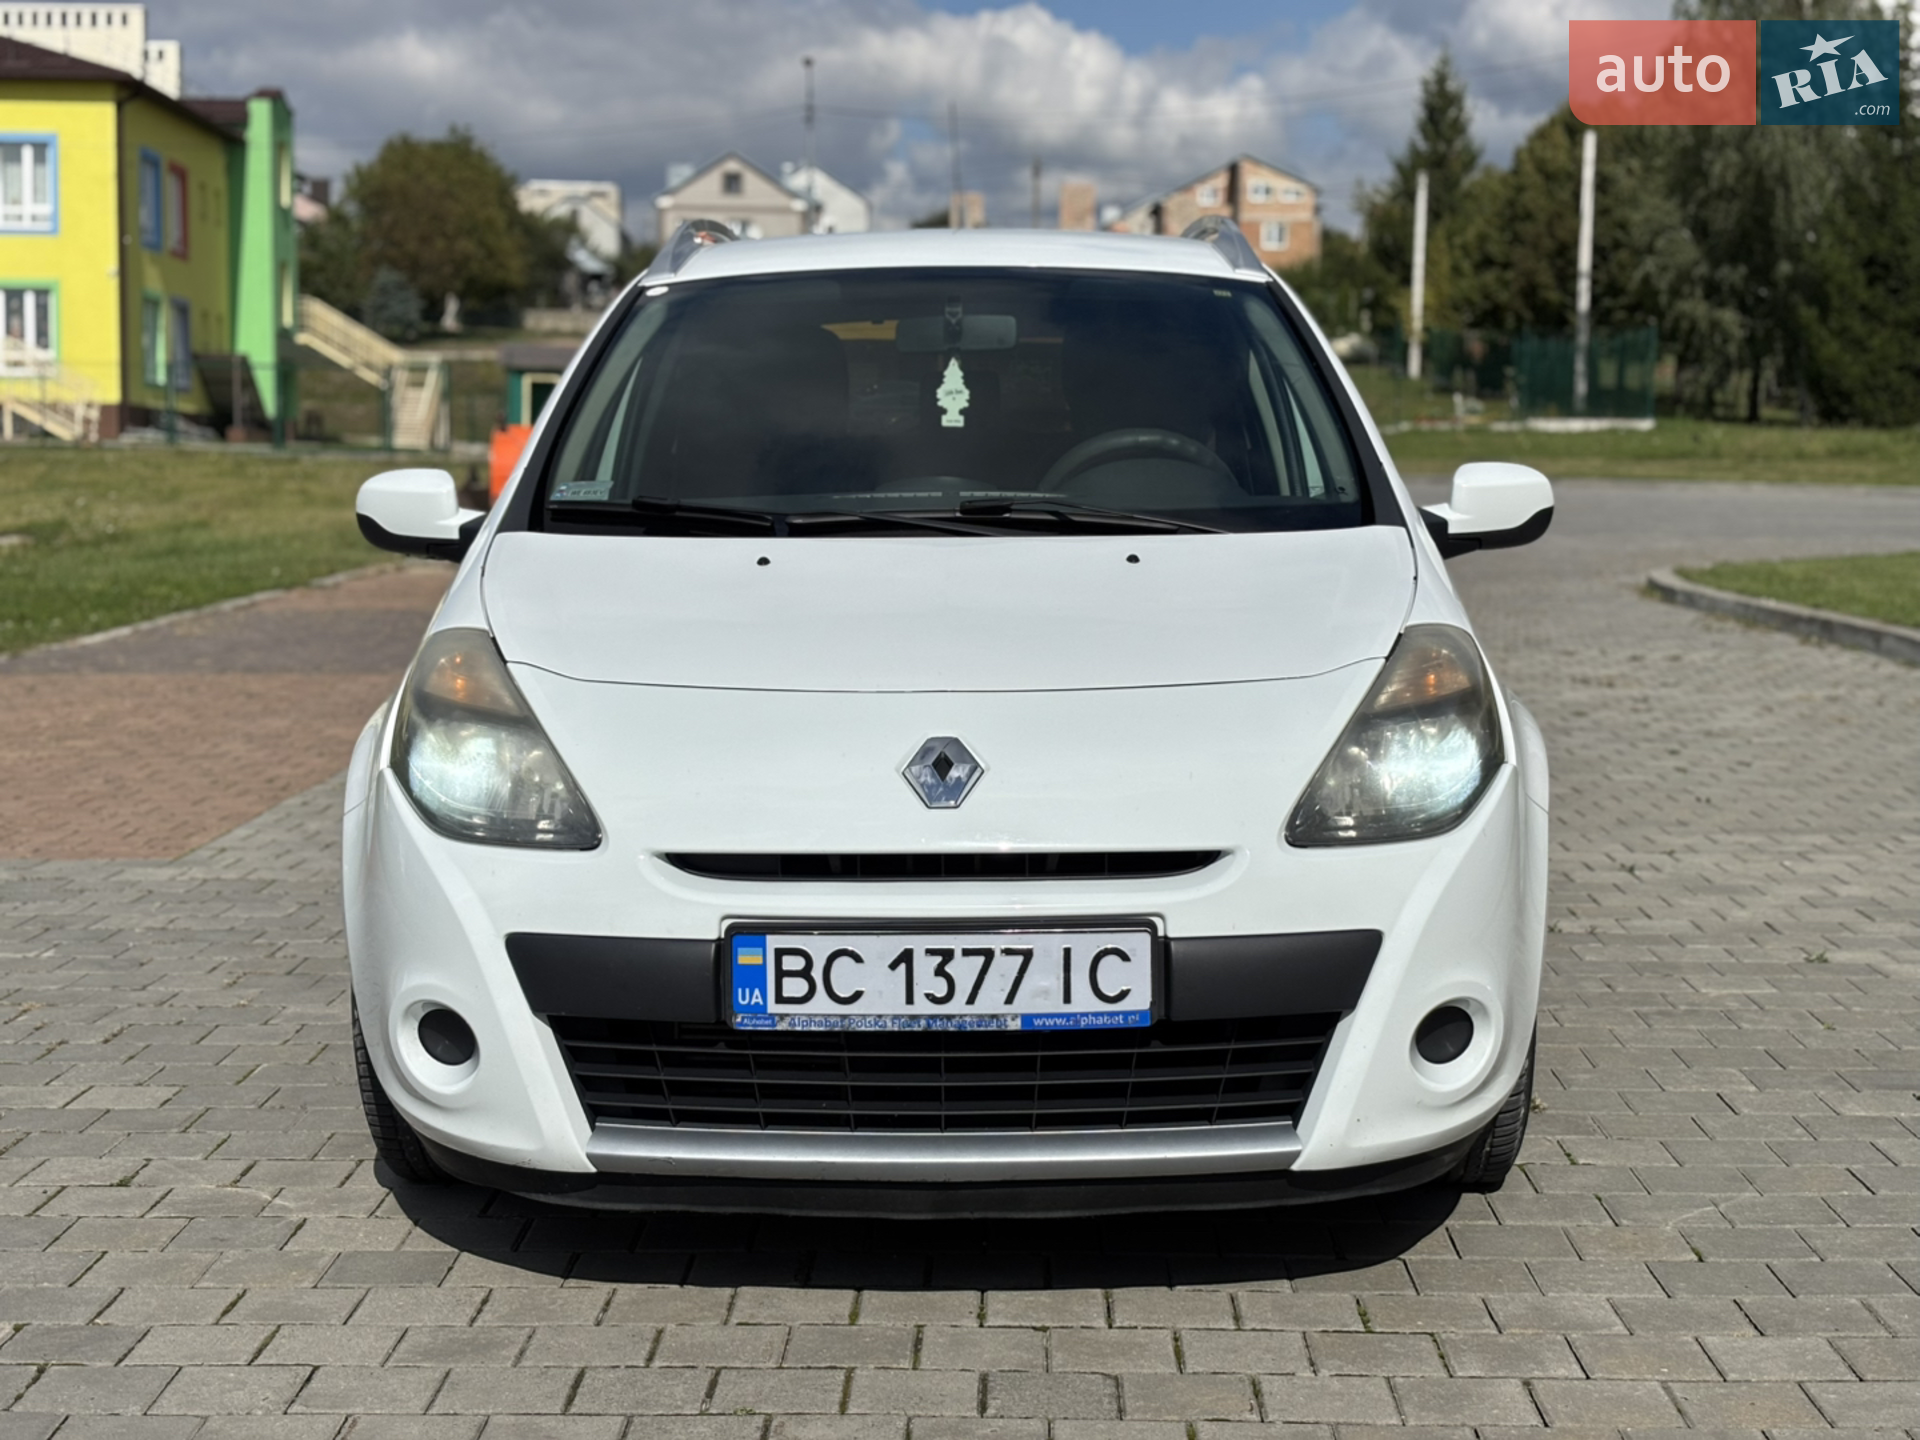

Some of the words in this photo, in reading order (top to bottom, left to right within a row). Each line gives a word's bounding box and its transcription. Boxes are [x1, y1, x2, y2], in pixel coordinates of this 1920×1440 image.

[773, 946, 866, 1006] BC
[887, 945, 1035, 1006] 1377
[1062, 944, 1132, 1005] IC
[737, 988, 764, 1006] UA
[788, 1016, 844, 1030] Alphabet
[848, 1016, 888, 1029] Polska
[1032, 1013, 1140, 1028] www.alphabetpl
